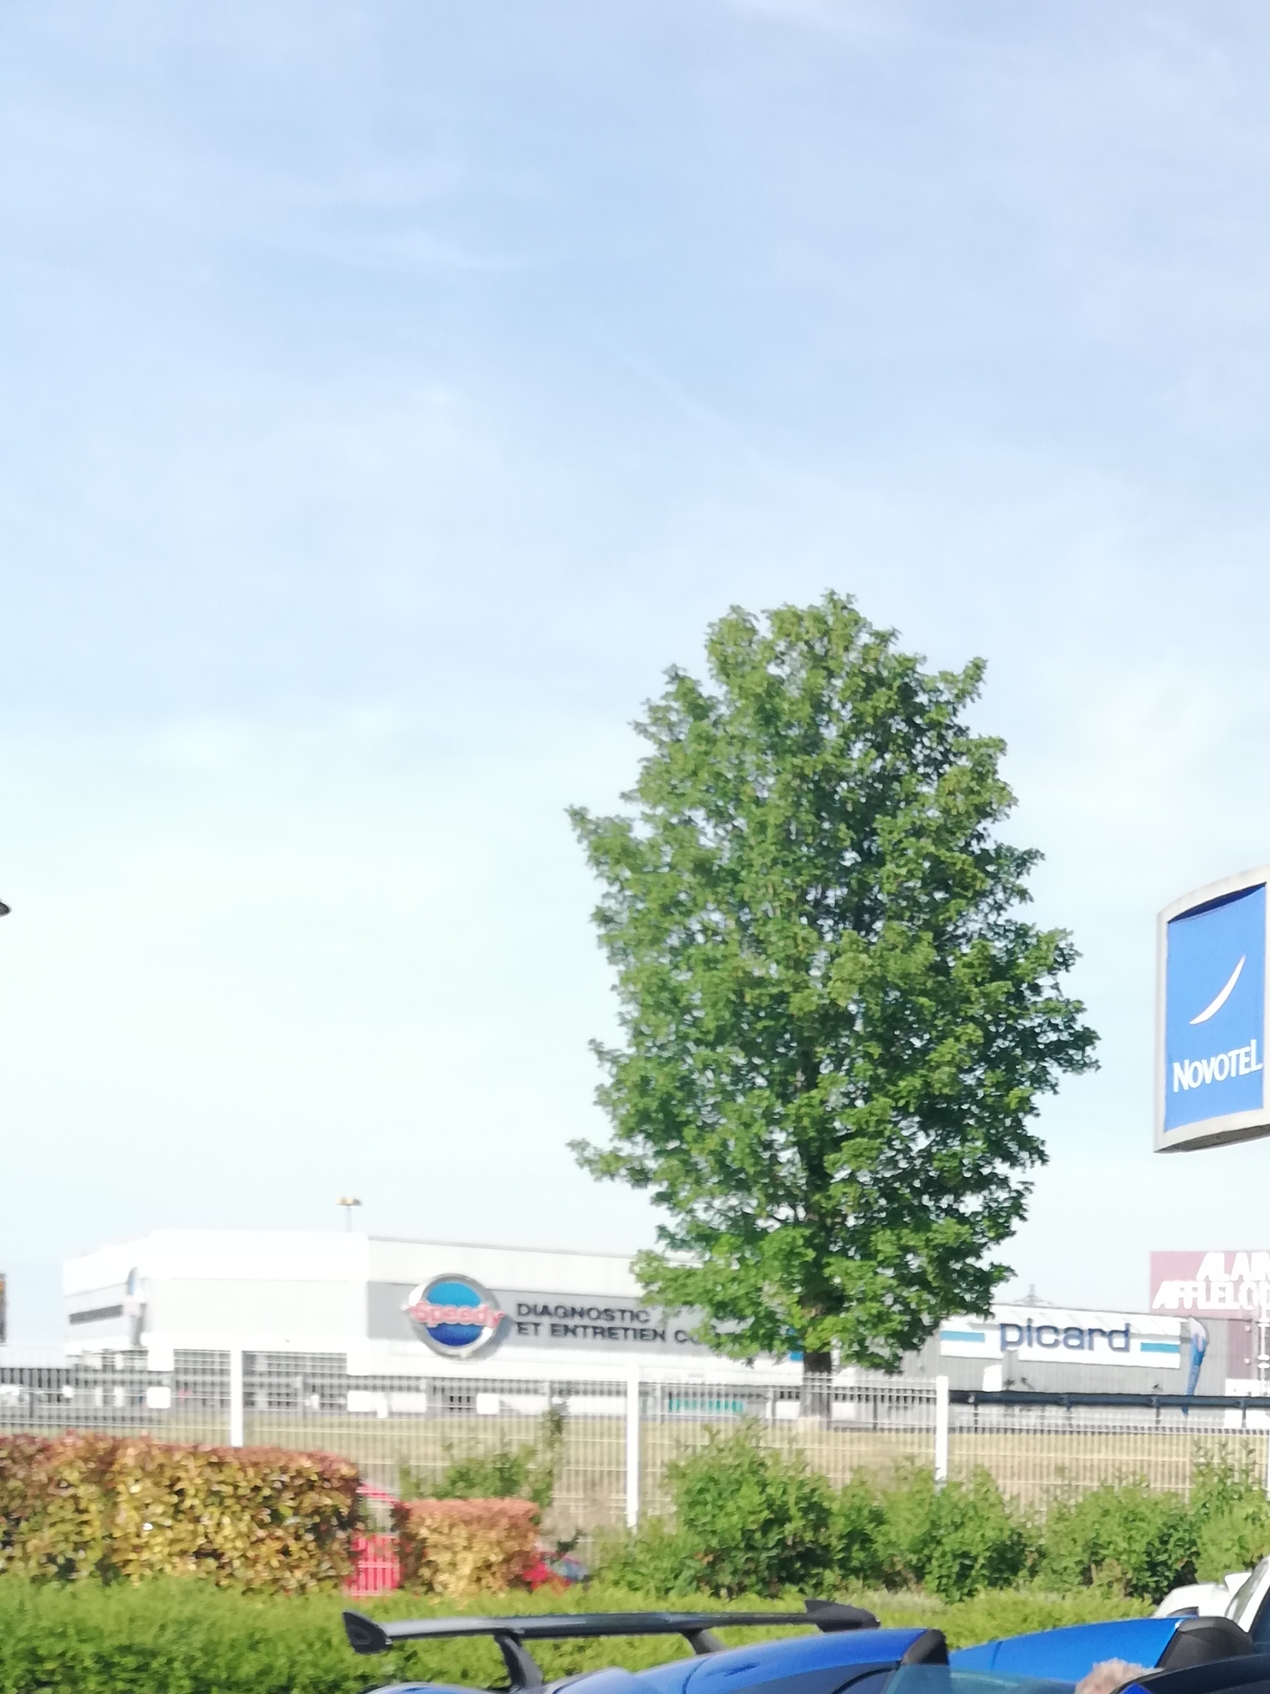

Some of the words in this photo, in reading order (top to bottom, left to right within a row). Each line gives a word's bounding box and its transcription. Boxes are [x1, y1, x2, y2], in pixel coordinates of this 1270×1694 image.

[1172, 1039, 1263, 1093] NOVOTEL
[517, 1303, 650, 1323] DIAGNOSTIC
[517, 1321, 541, 1336] ET
[551, 1323, 667, 1342] ENTRETIEN
[1000, 1317, 1131, 1352] picard
